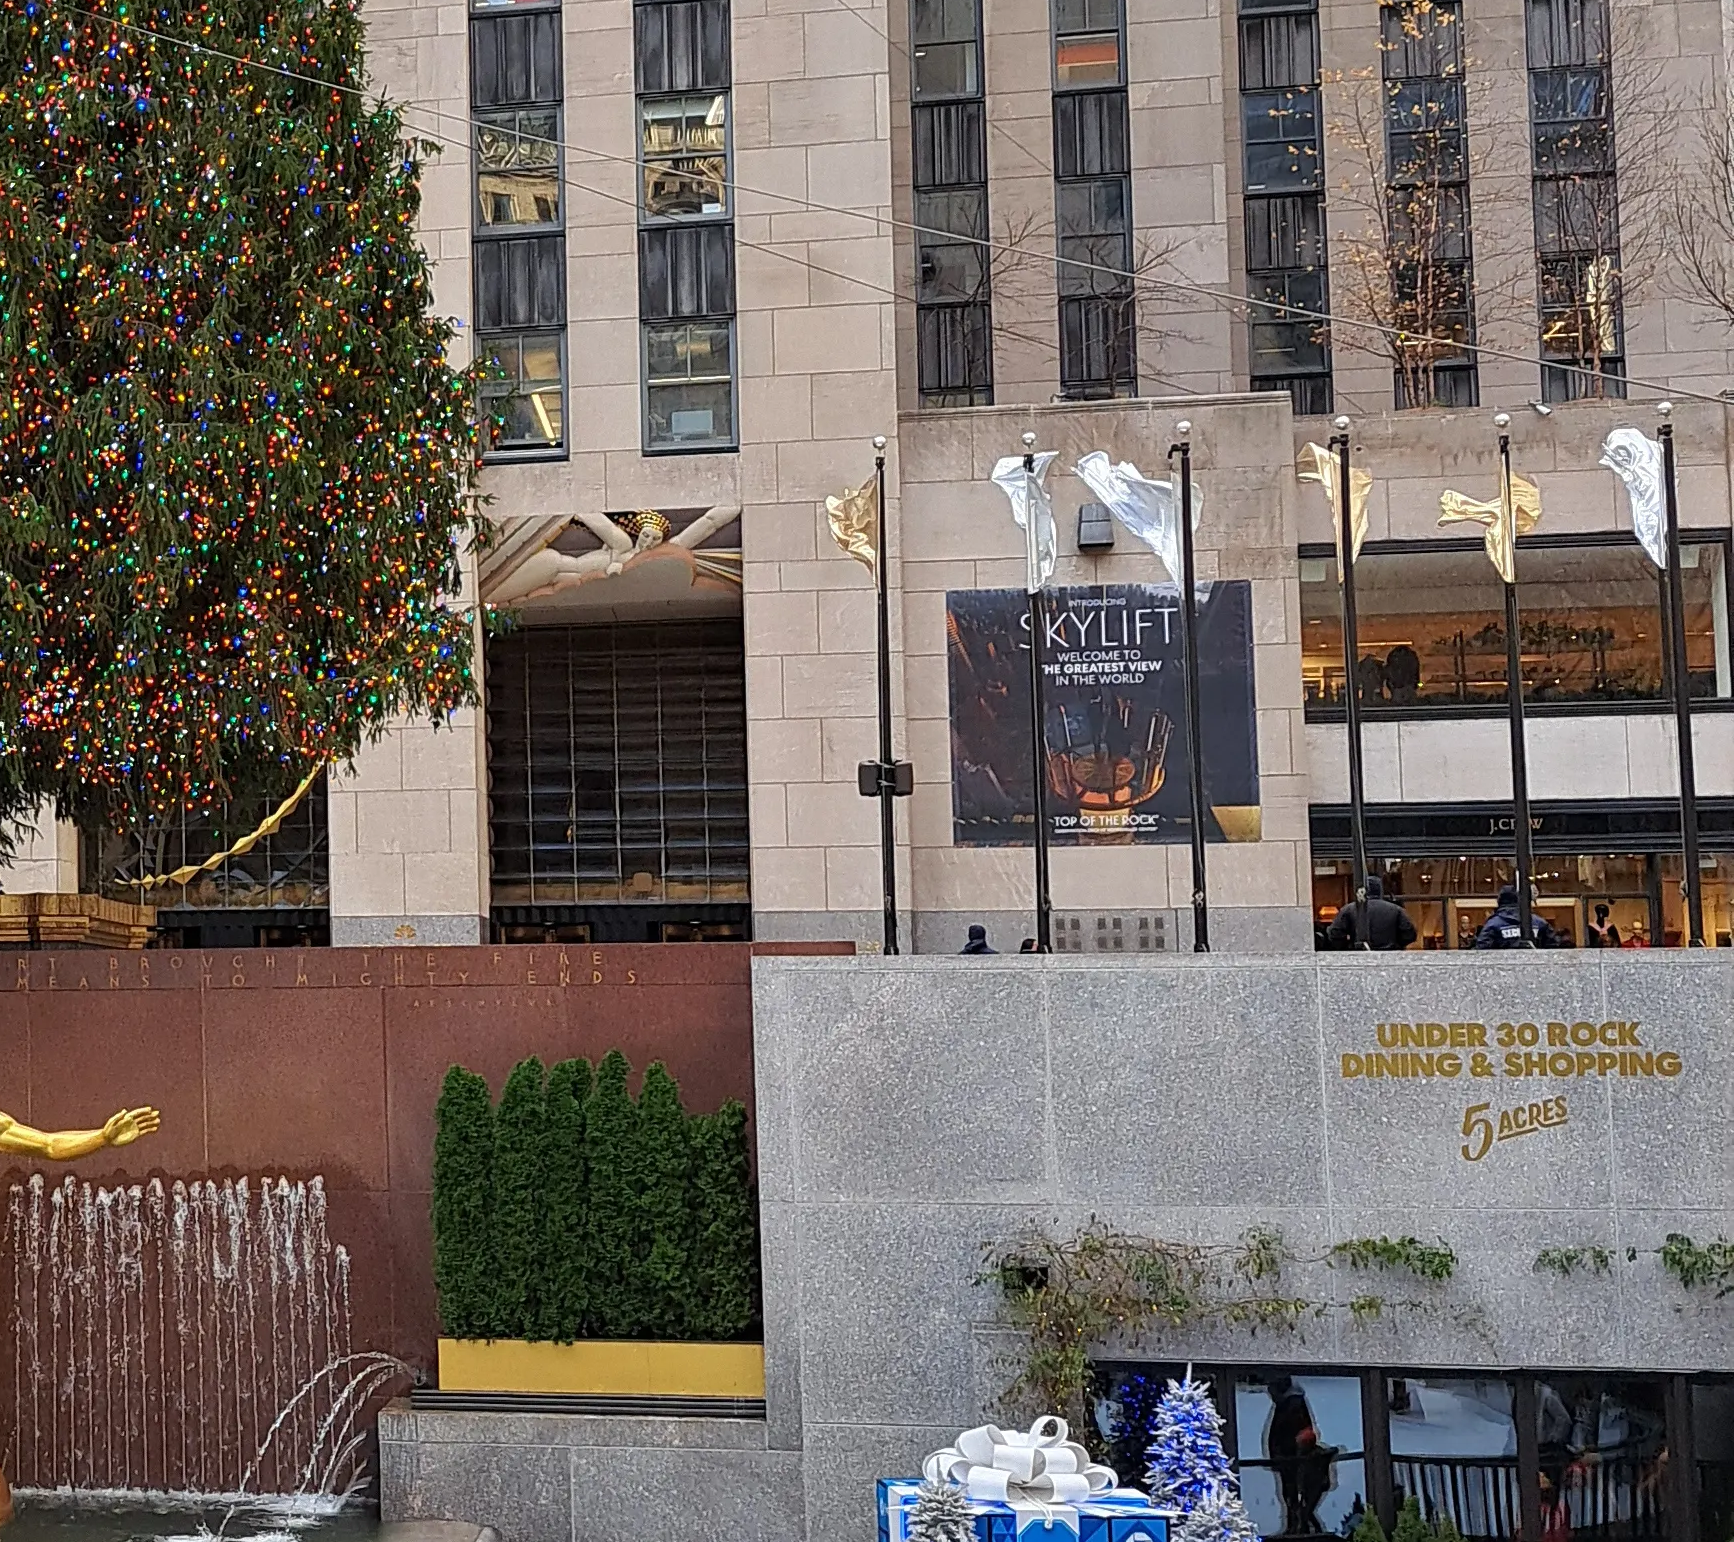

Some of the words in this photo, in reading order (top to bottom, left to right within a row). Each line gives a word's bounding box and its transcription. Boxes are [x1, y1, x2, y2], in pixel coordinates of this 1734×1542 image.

[1068, 597, 1127, 608] INTRODUCING
[1057, 650, 1121, 662] WELCOME
[1123, 649, 1141, 660] TO
[1063, 662, 1126, 673] GREATEST
[1128, 660, 1162, 672] VIEW
[1056, 675, 1069, 686] IN
[1072, 674, 1096, 685] THE
[1099, 672, 1145, 684] WORLD
[1054, 816, 1078, 827] TOP
[1079, 815, 1096, 826] OF
[1098, 815, 1119, 825] THE
[362, 952, 436, 967] THE
[493, 951, 603, 966] FIRE
[15, 975, 151, 989] MEANS
[203, 974, 246, 987] TO
[295, 970, 471, 986] MIGHTY
[526, 970, 637, 985] ENDS
[1377, 1023, 1488, 1048] UNDER
[1497, 1022, 1541, 1047] 30
[1547, 1021, 1641, 1047] ROCK
[1342, 1052, 1463, 1078] DINING
[1470, 1052, 1496, 1077] &
[1504, 1052, 1682, 1077] SHOPPING
[1461, 1102, 1494, 1162] 5
[1498, 1095, 1567, 1134] ACRES
